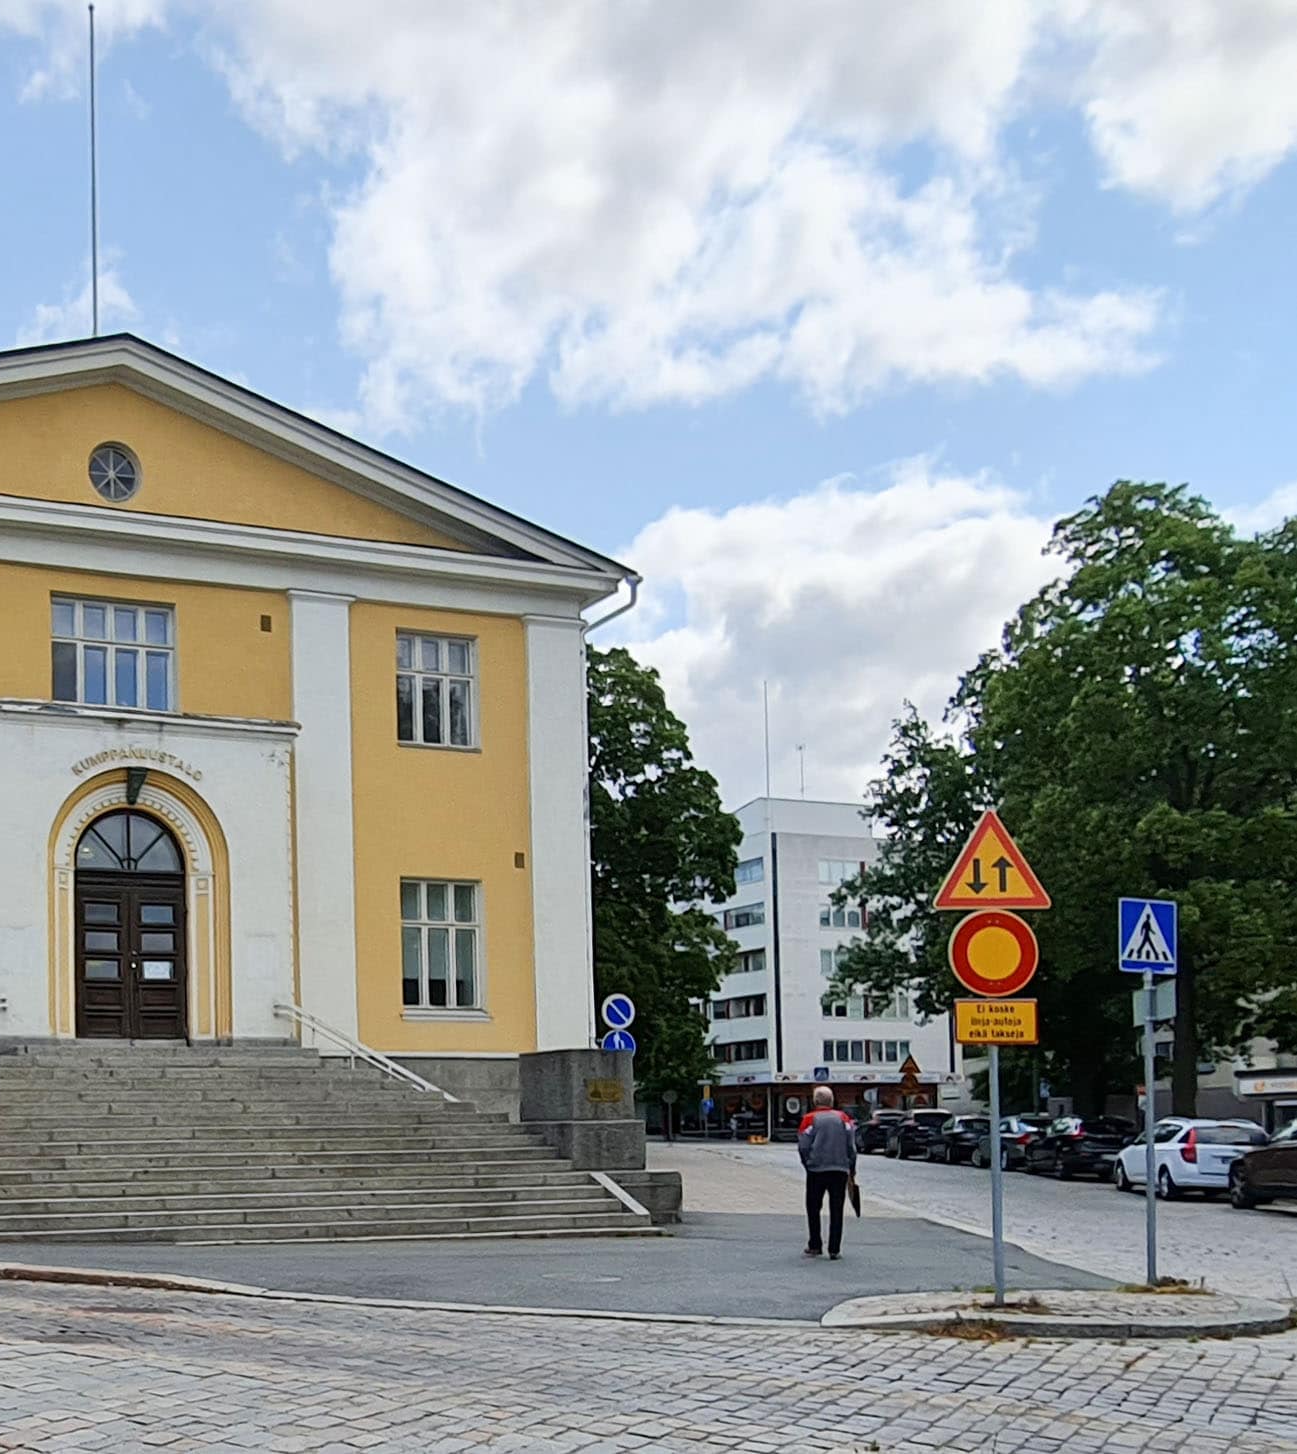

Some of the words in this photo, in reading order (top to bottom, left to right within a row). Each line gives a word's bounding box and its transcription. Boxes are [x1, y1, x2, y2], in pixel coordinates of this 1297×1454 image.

[977, 1004, 985, 1013] Ei
[989, 1004, 1015, 1013] koske
[970, 1016, 1022, 1027] linja-autoja
[969, 1029, 987, 1039] eikä
[991, 1029, 1024, 1039] takseja
